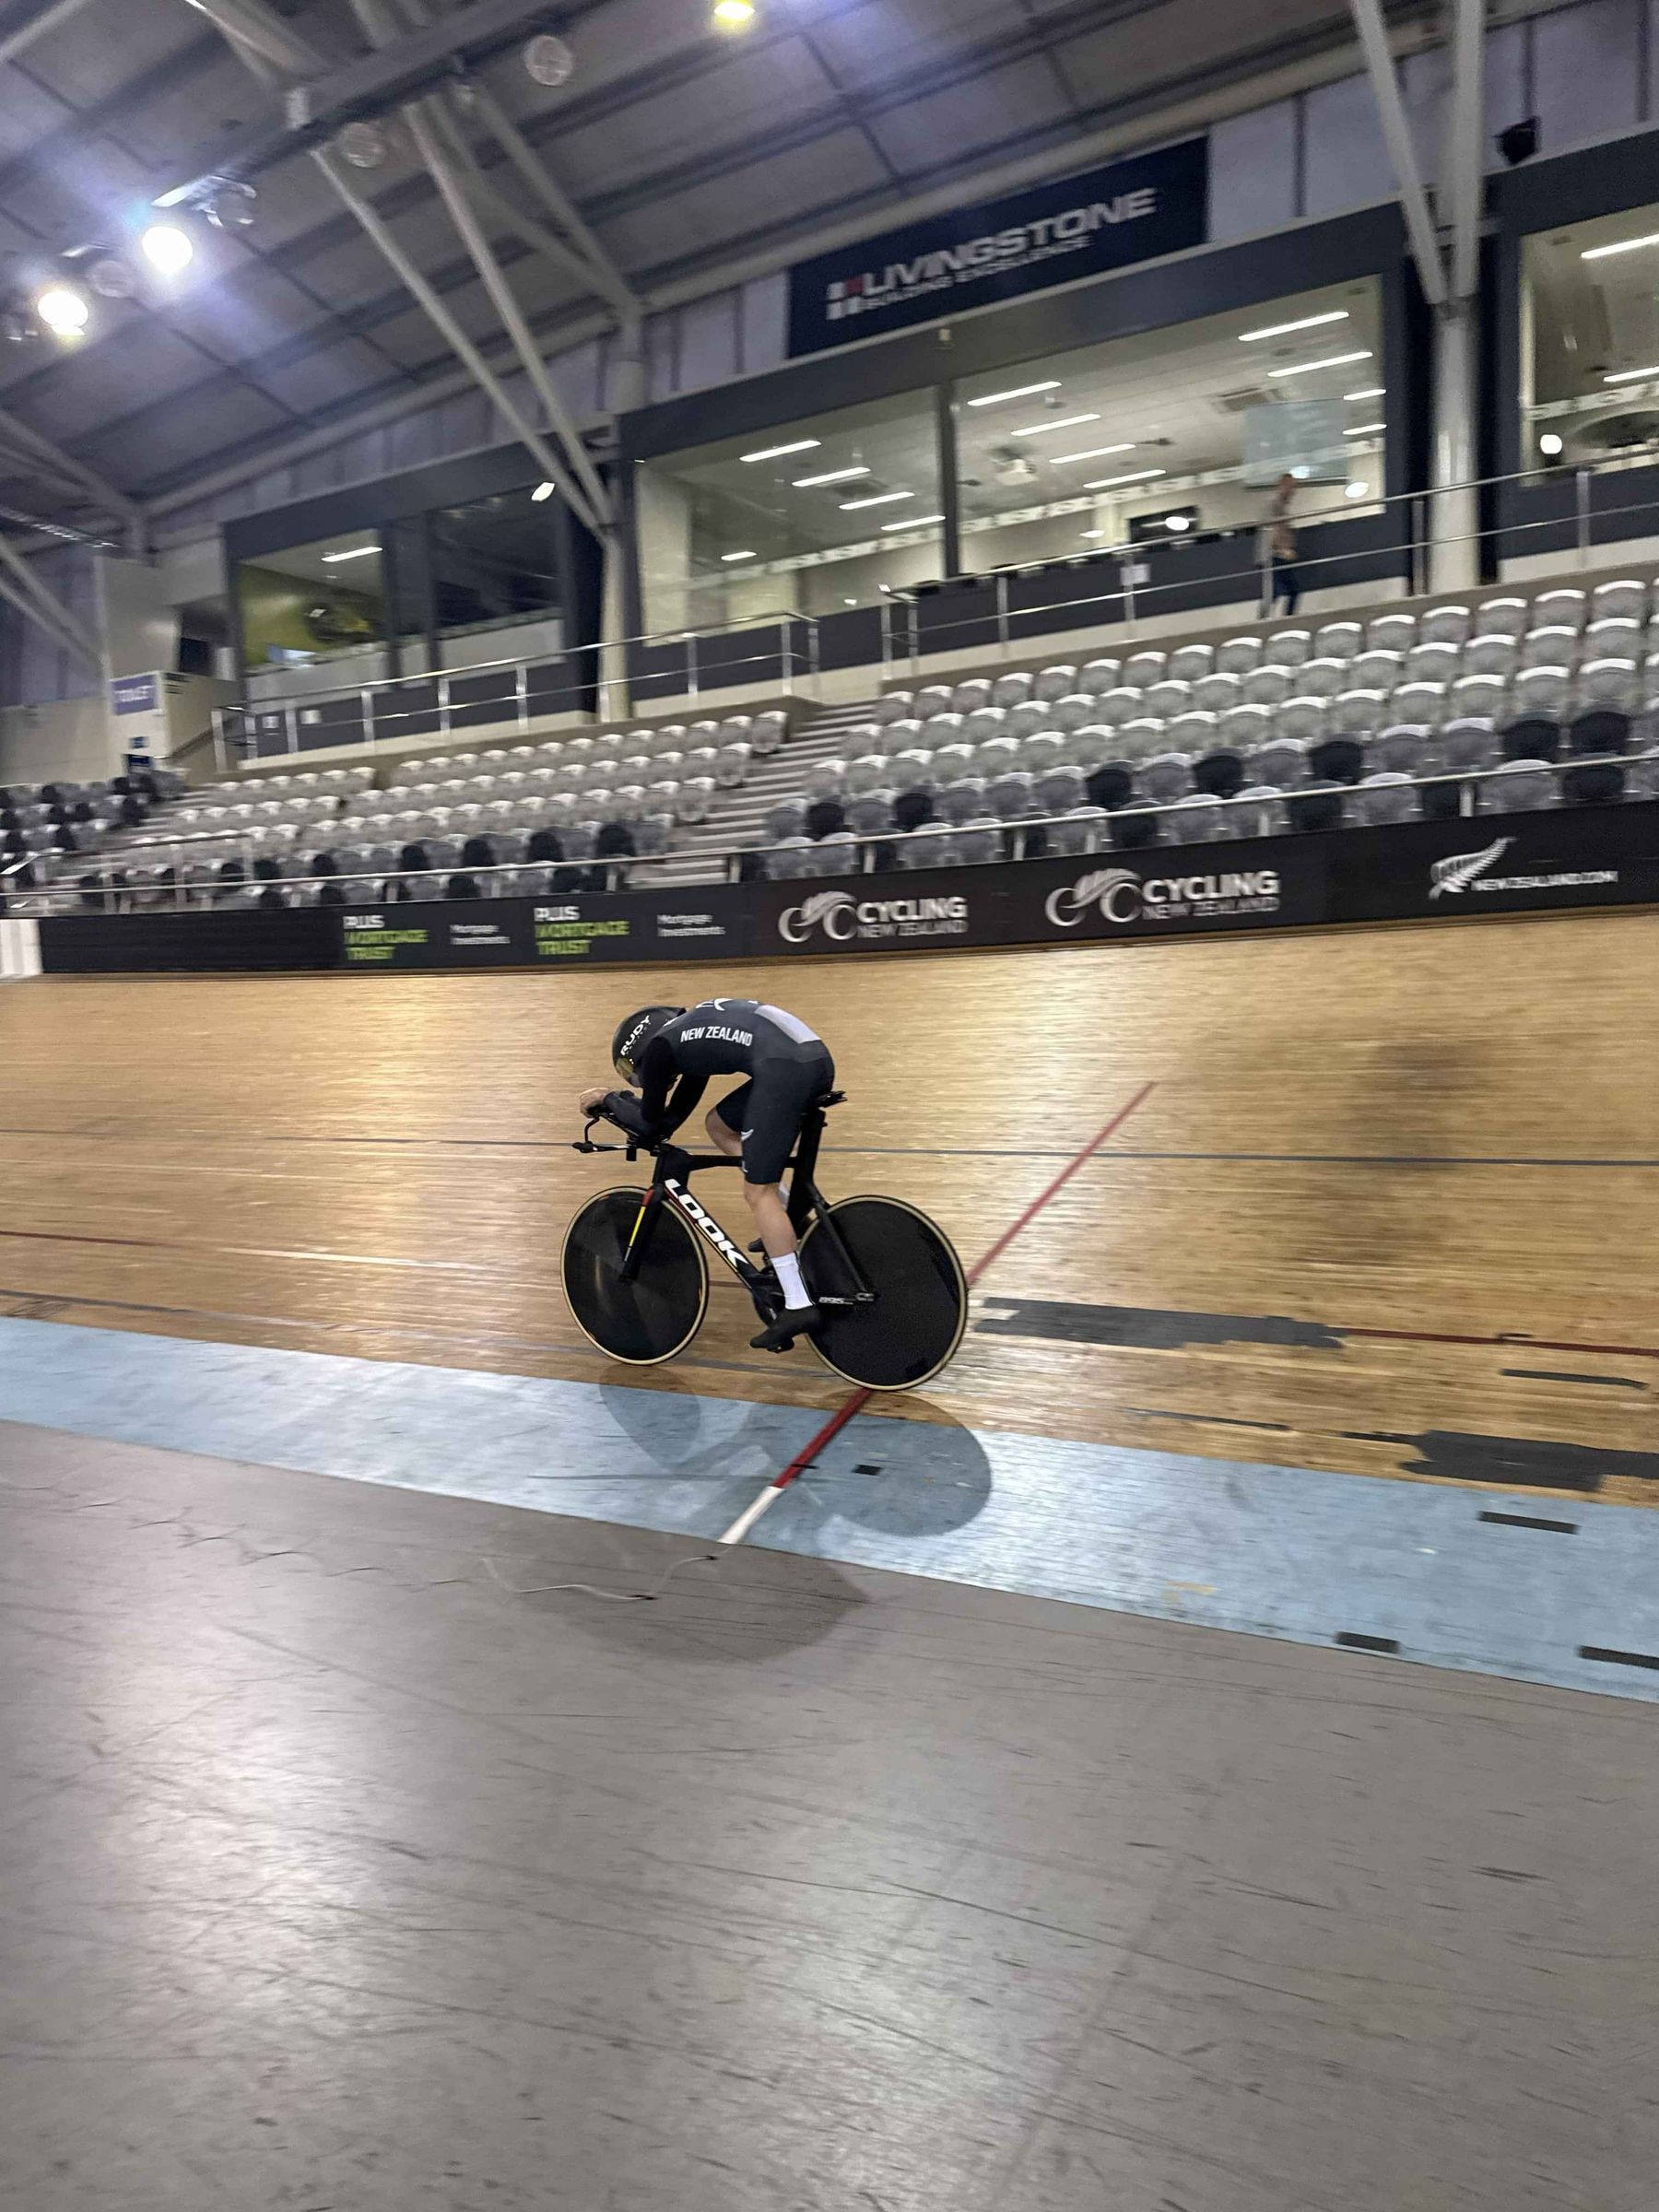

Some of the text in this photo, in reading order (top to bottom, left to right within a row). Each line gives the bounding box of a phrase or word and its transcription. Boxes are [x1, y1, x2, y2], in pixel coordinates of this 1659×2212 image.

[863, 187, 1158, 296] LIVINGSTONE
[1143, 870, 1280, 902] CYCLING
[856, 897, 968, 924] CYCLING
[1142, 897, 1280, 920] NEW ZEALAND
[857, 920, 968, 938] NEW ZEALAND
[620, 1015, 651, 1056] RUDY
[680, 1026, 753, 1047] NEW ZEALAND
[665, 1178, 749, 1266] LOOK
